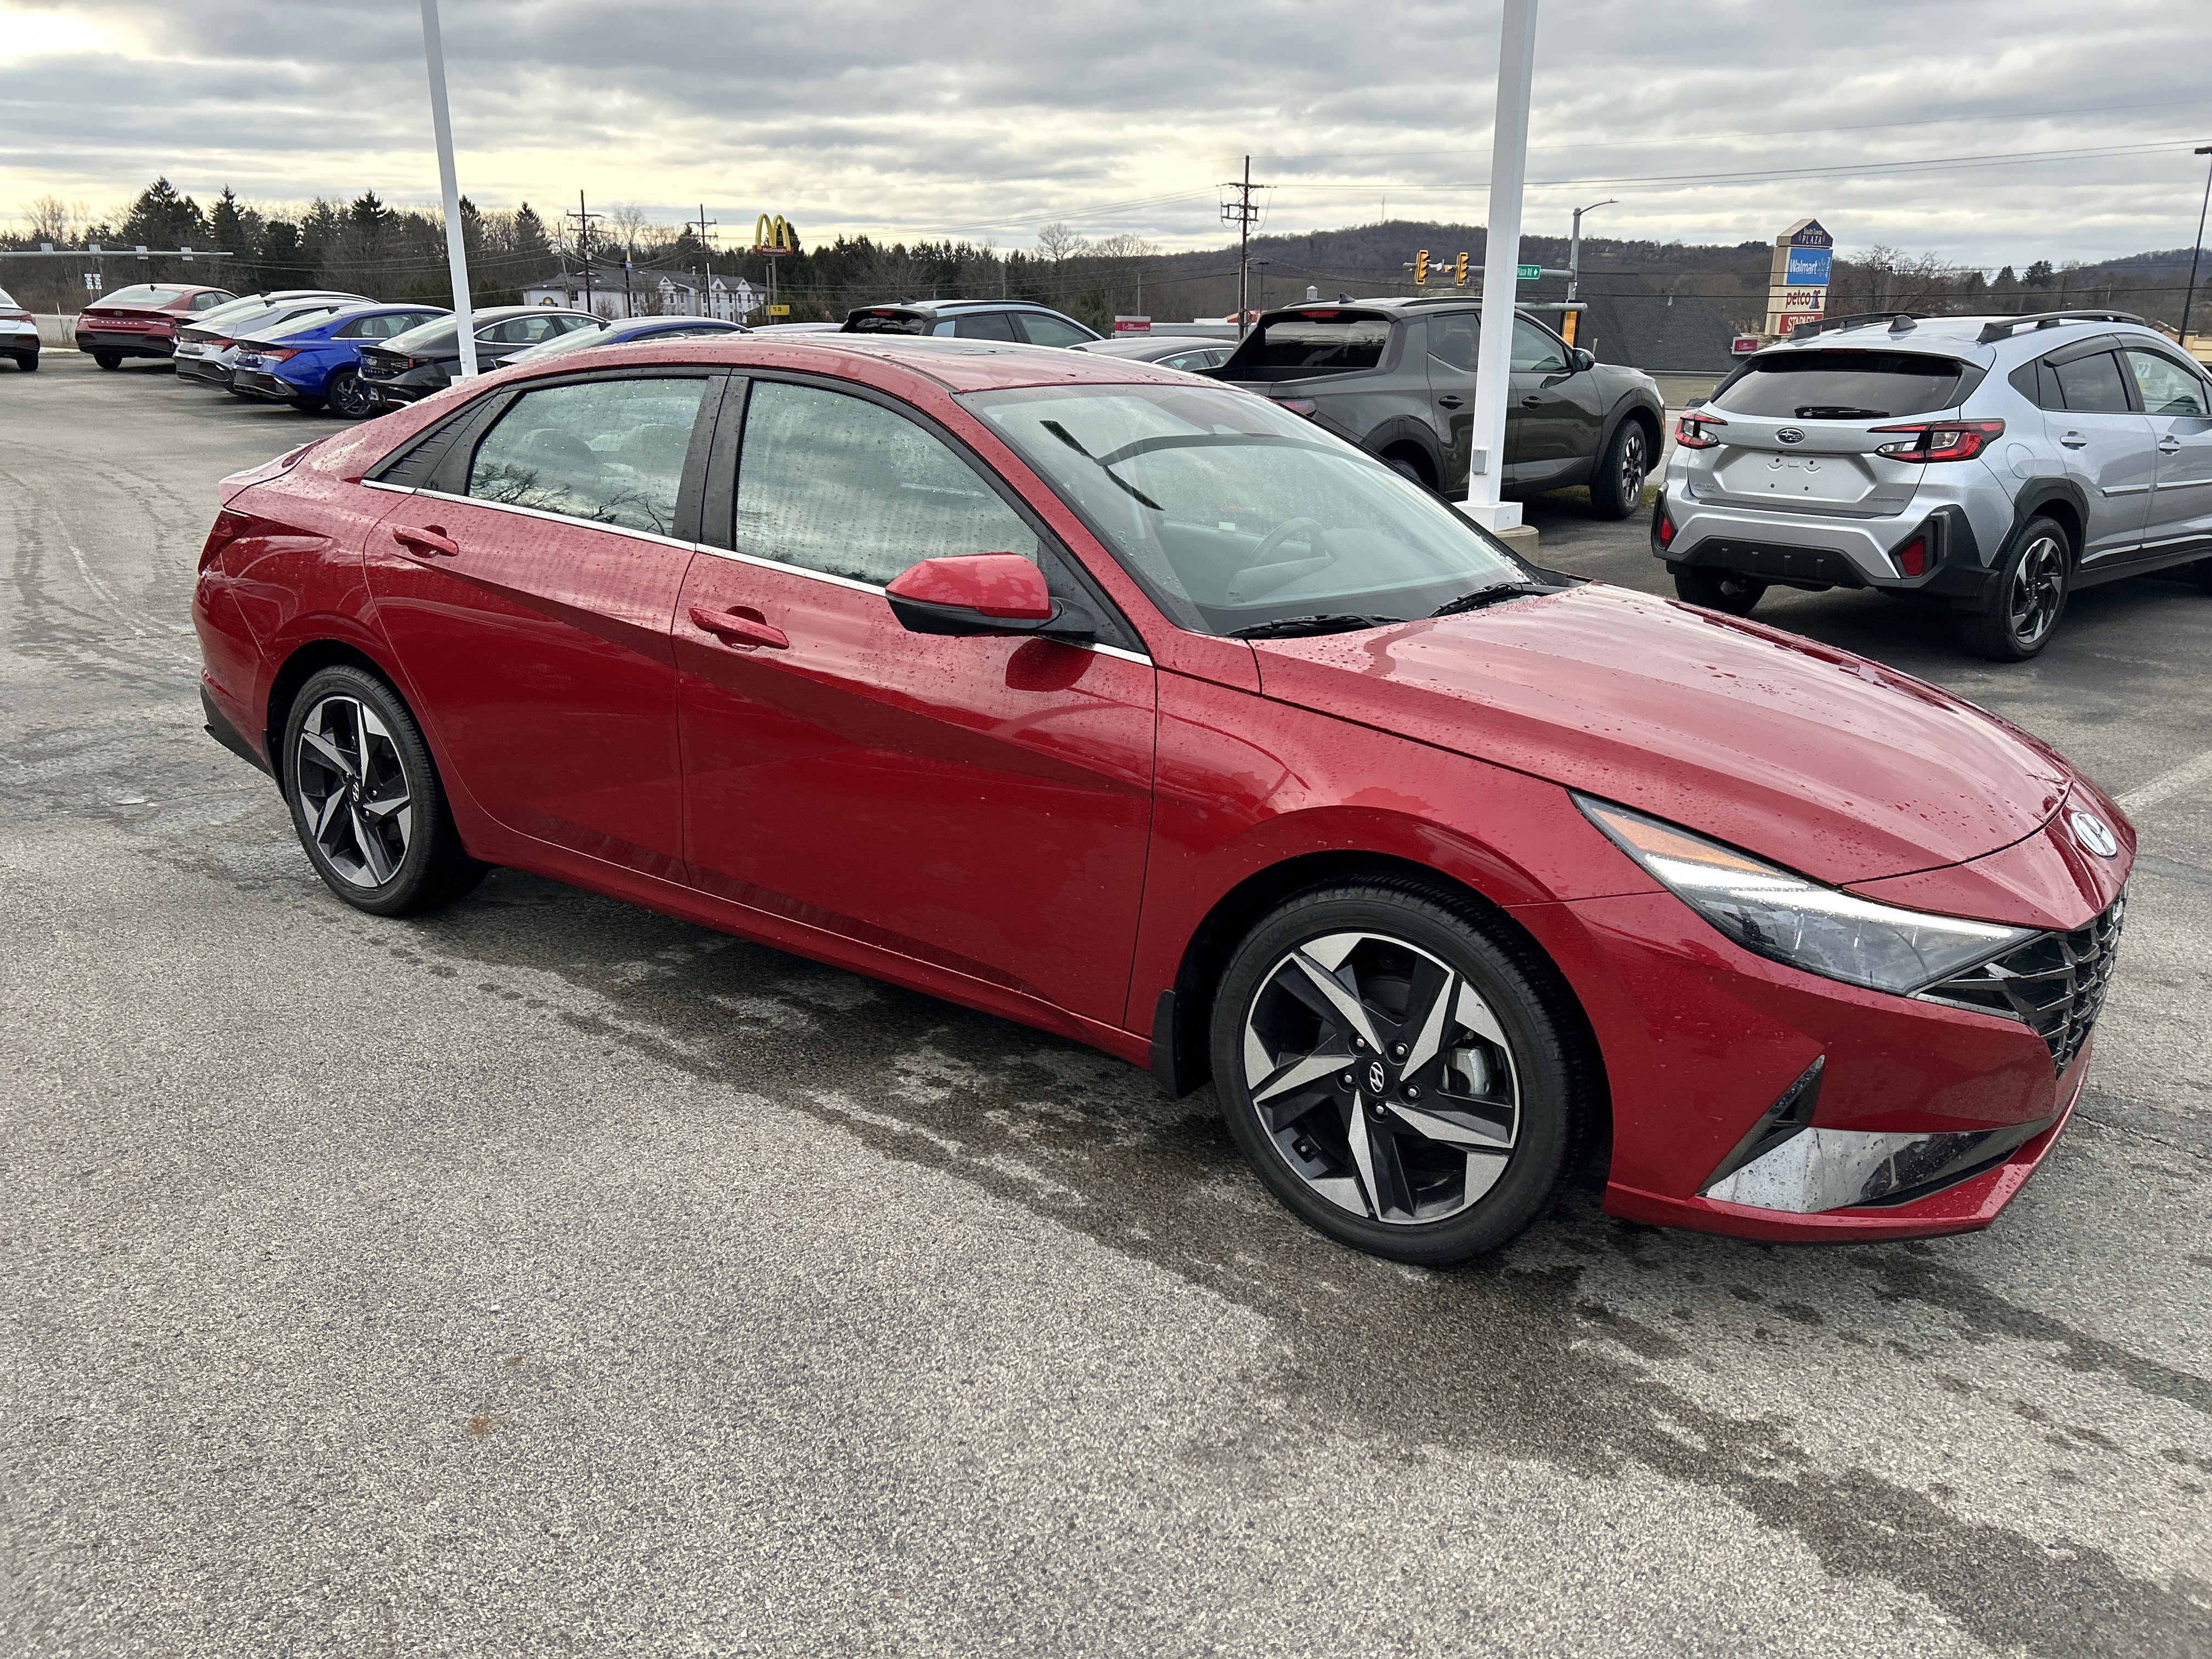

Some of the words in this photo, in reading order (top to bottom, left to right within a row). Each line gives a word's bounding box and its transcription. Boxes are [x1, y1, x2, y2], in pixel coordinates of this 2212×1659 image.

[1802, 235, 1822, 245] PLAZA
[1790, 259, 1818, 275] Walmart
[1786, 290, 1811, 309] petco
